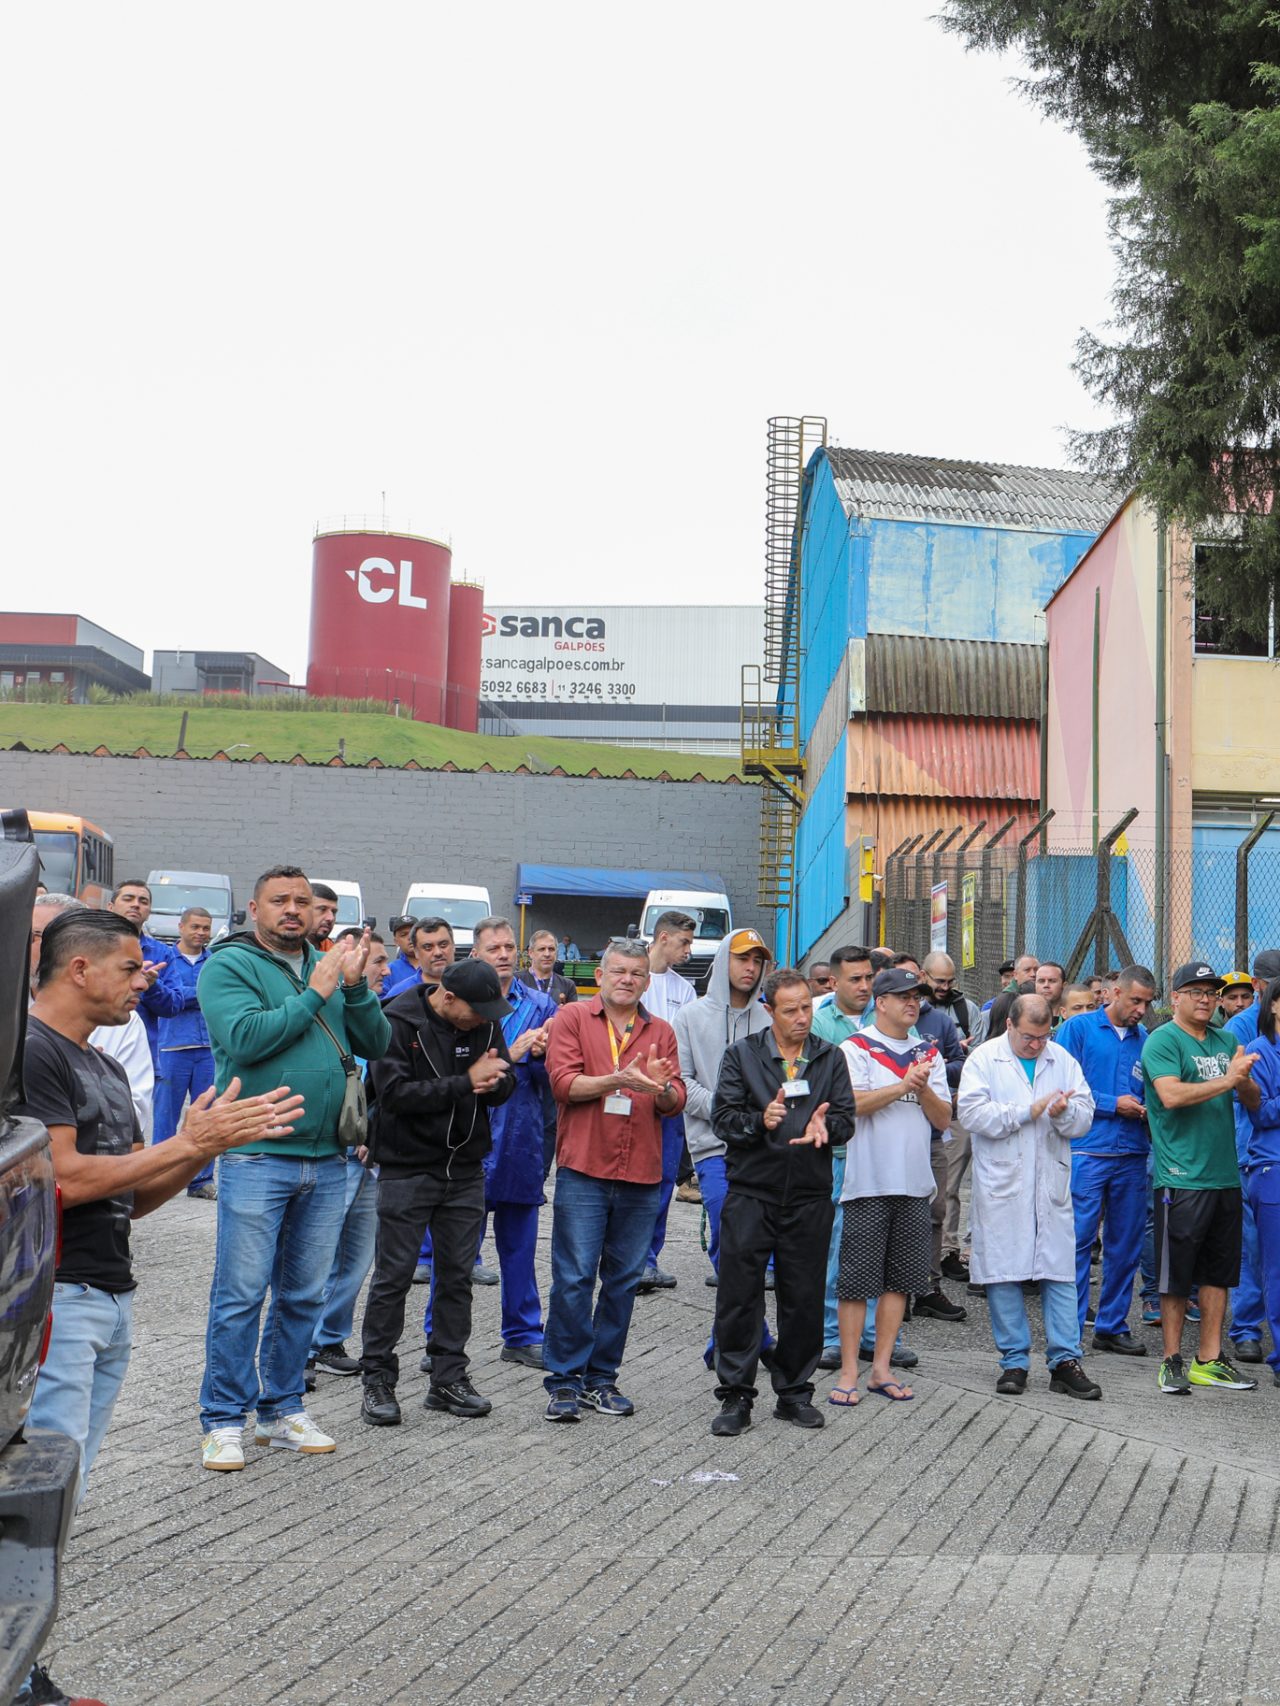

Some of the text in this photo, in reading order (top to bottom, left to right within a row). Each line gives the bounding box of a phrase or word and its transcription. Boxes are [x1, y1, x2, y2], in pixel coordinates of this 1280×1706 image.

[357, 556, 428, 610] CL
[500, 615, 606, 639] sanca
[554, 640, 605, 652] GALPÕES
[480, 656, 626, 673] .sancagalpoes.com.br
[516, 681, 547, 694] 6683
[570, 682, 602, 695] 3246
[607, 683, 637, 696] 3300
